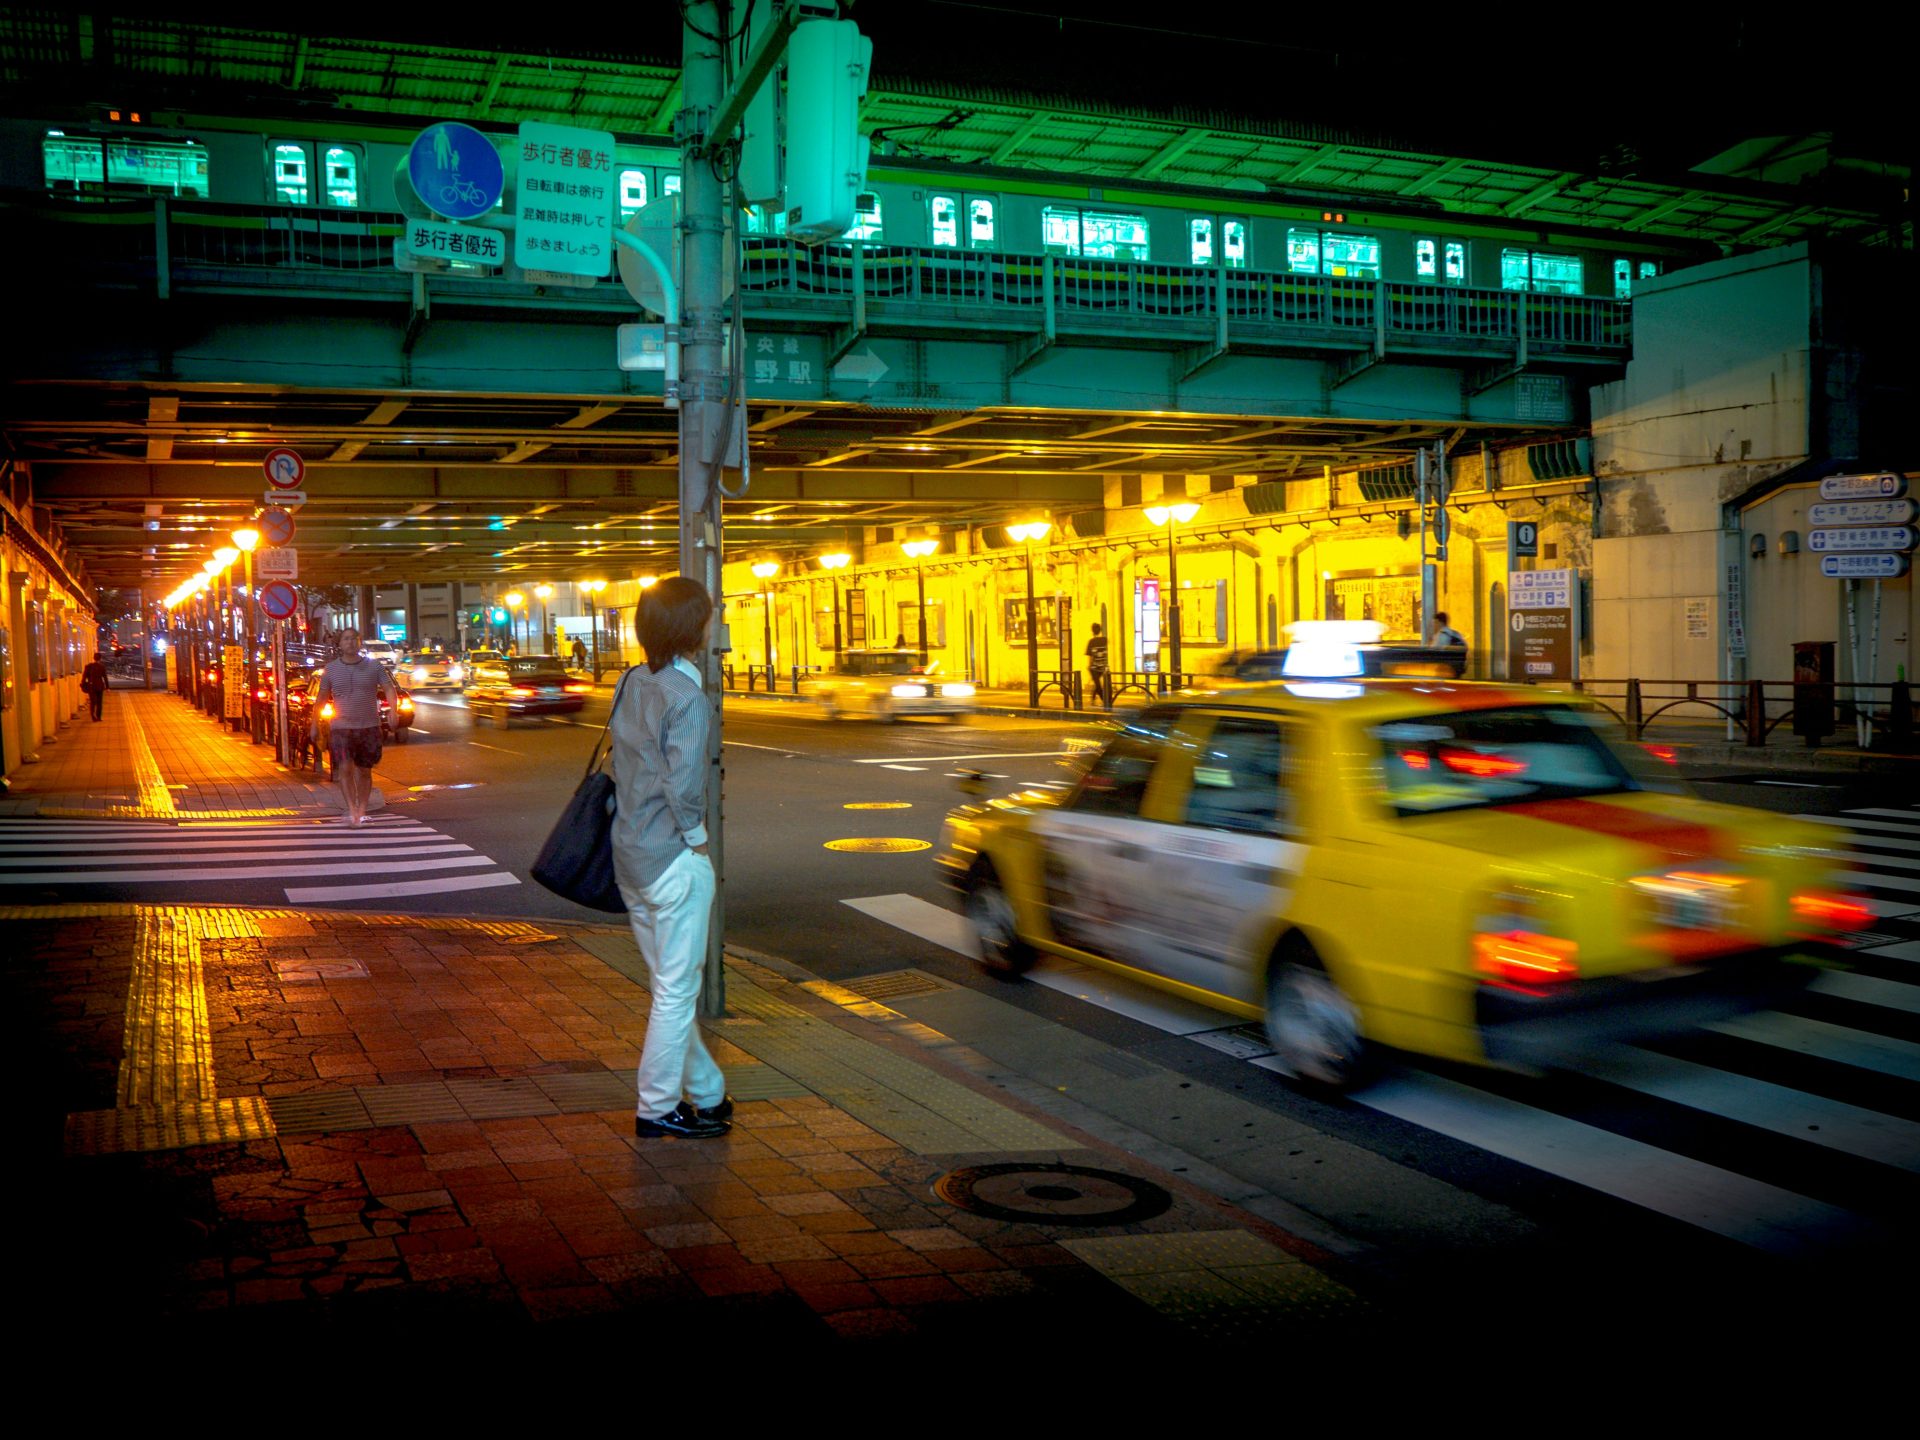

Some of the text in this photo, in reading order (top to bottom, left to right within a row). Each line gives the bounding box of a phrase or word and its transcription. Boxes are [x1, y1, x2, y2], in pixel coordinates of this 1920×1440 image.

[523, 142, 611, 172] 歩行者優先
[526, 178, 604, 199] 自転車は徐行
[523, 207, 606, 228] 混雑時は押して
[414, 228, 497, 257] 歩行者優先
[525, 237, 601, 257] 歩きましょう
[743, 336, 800, 355] 央線
